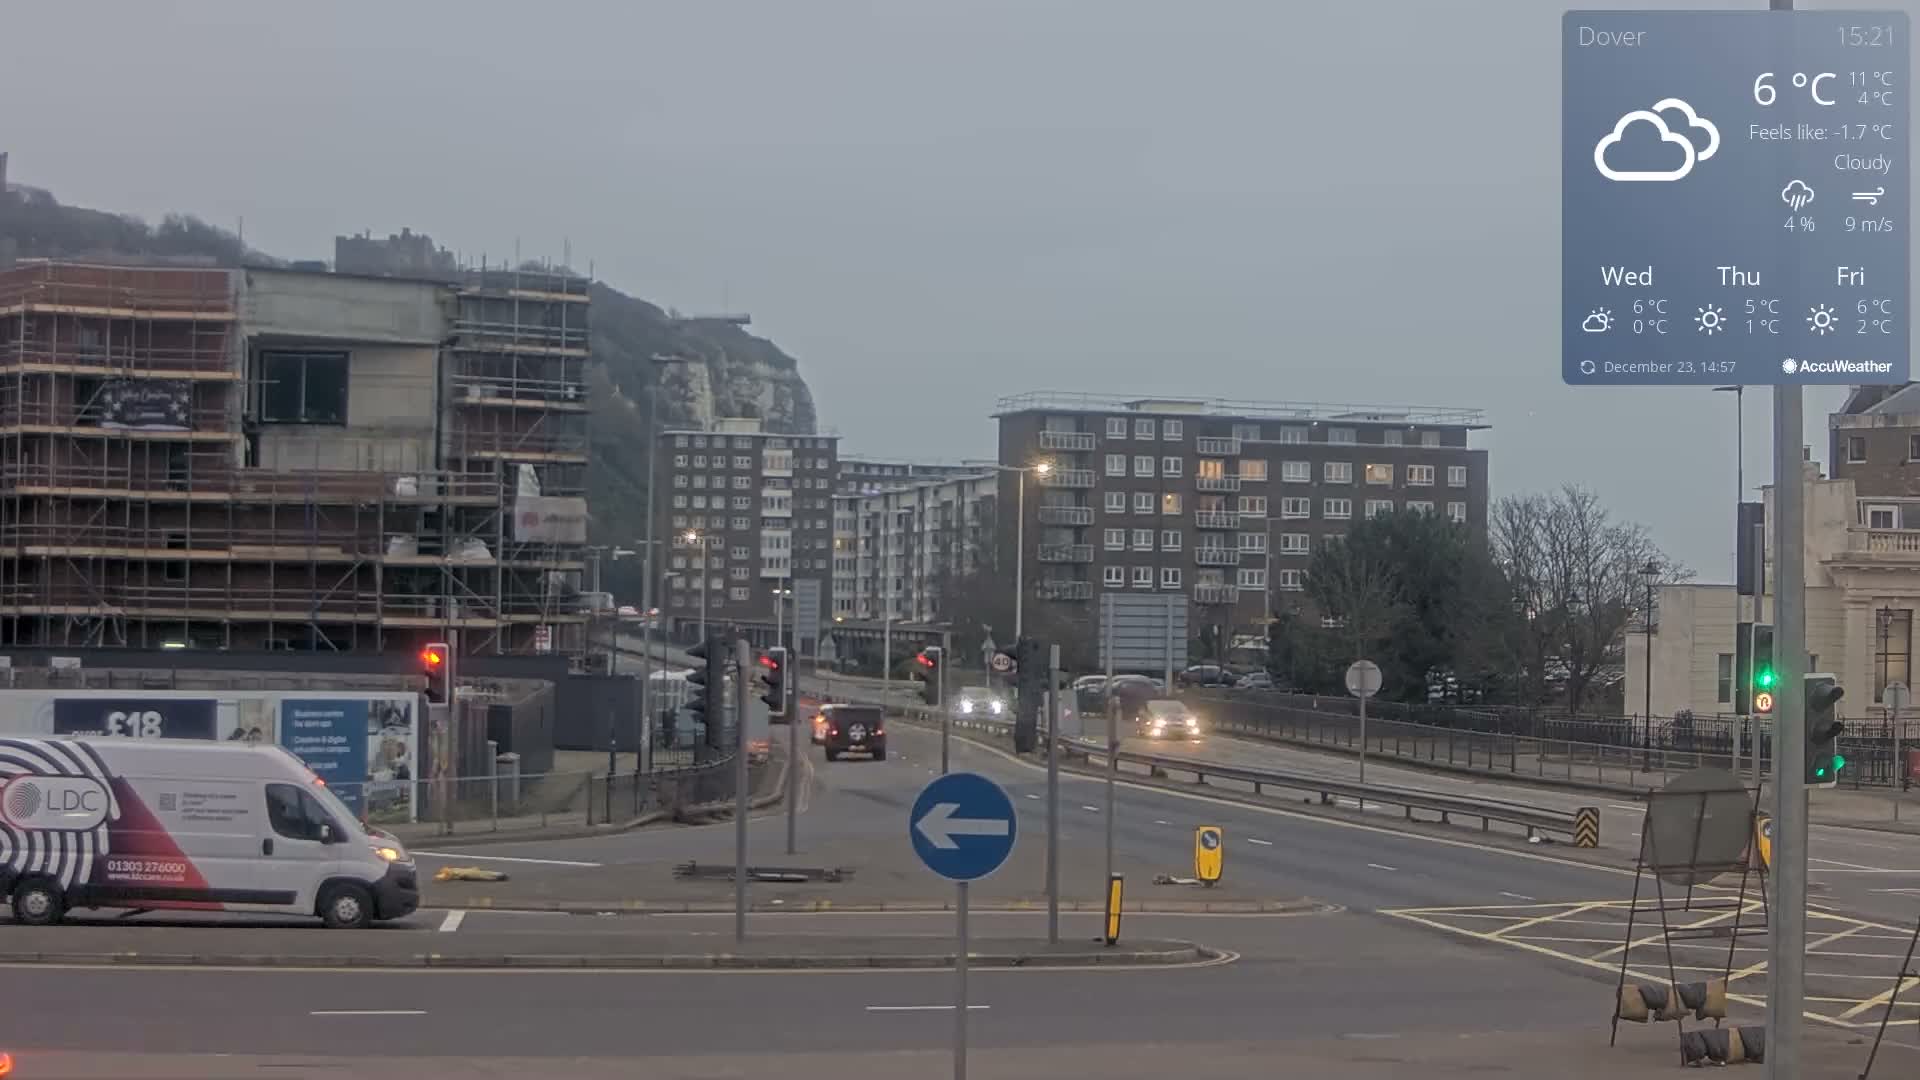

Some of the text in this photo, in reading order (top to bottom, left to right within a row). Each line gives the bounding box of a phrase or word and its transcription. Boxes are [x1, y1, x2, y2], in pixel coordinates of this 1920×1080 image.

[994, 657, 1009, 666] 40
[47, 789, 100, 812] LDC
[107, 860, 186, 873] 01303 276000
